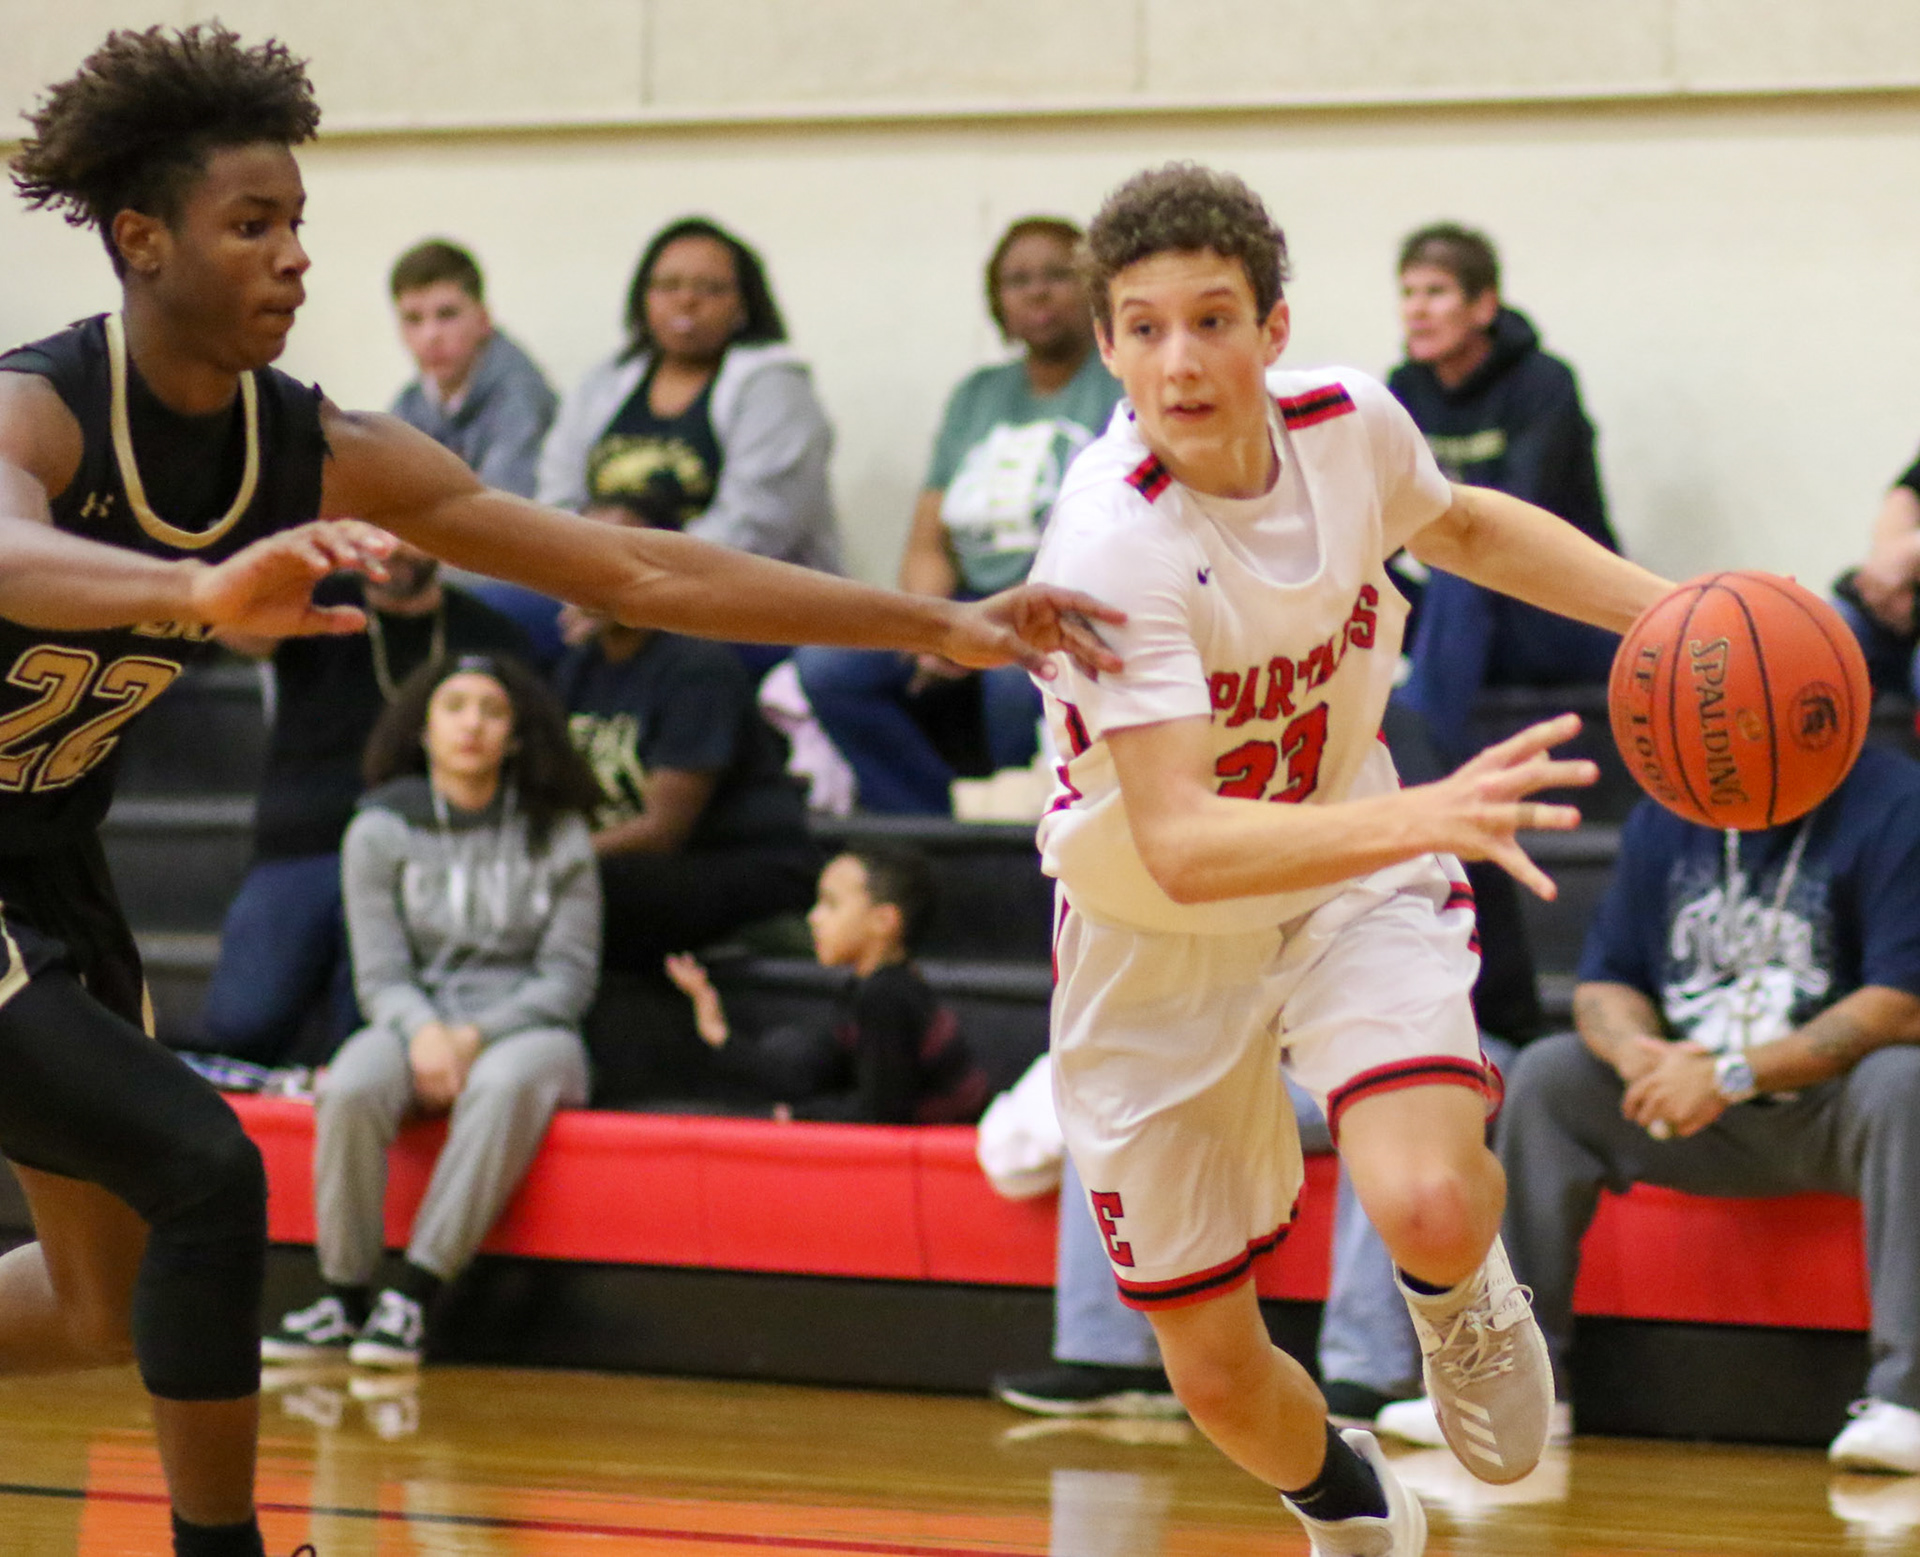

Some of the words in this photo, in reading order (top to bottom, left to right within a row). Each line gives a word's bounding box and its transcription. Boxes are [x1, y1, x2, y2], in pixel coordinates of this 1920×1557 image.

[3, 644, 182, 793] 22
[1206, 584, 1379, 728] PARTS
[1689, 637, 1751, 806] SPALDING
[1090, 1189, 1135, 1268] E
